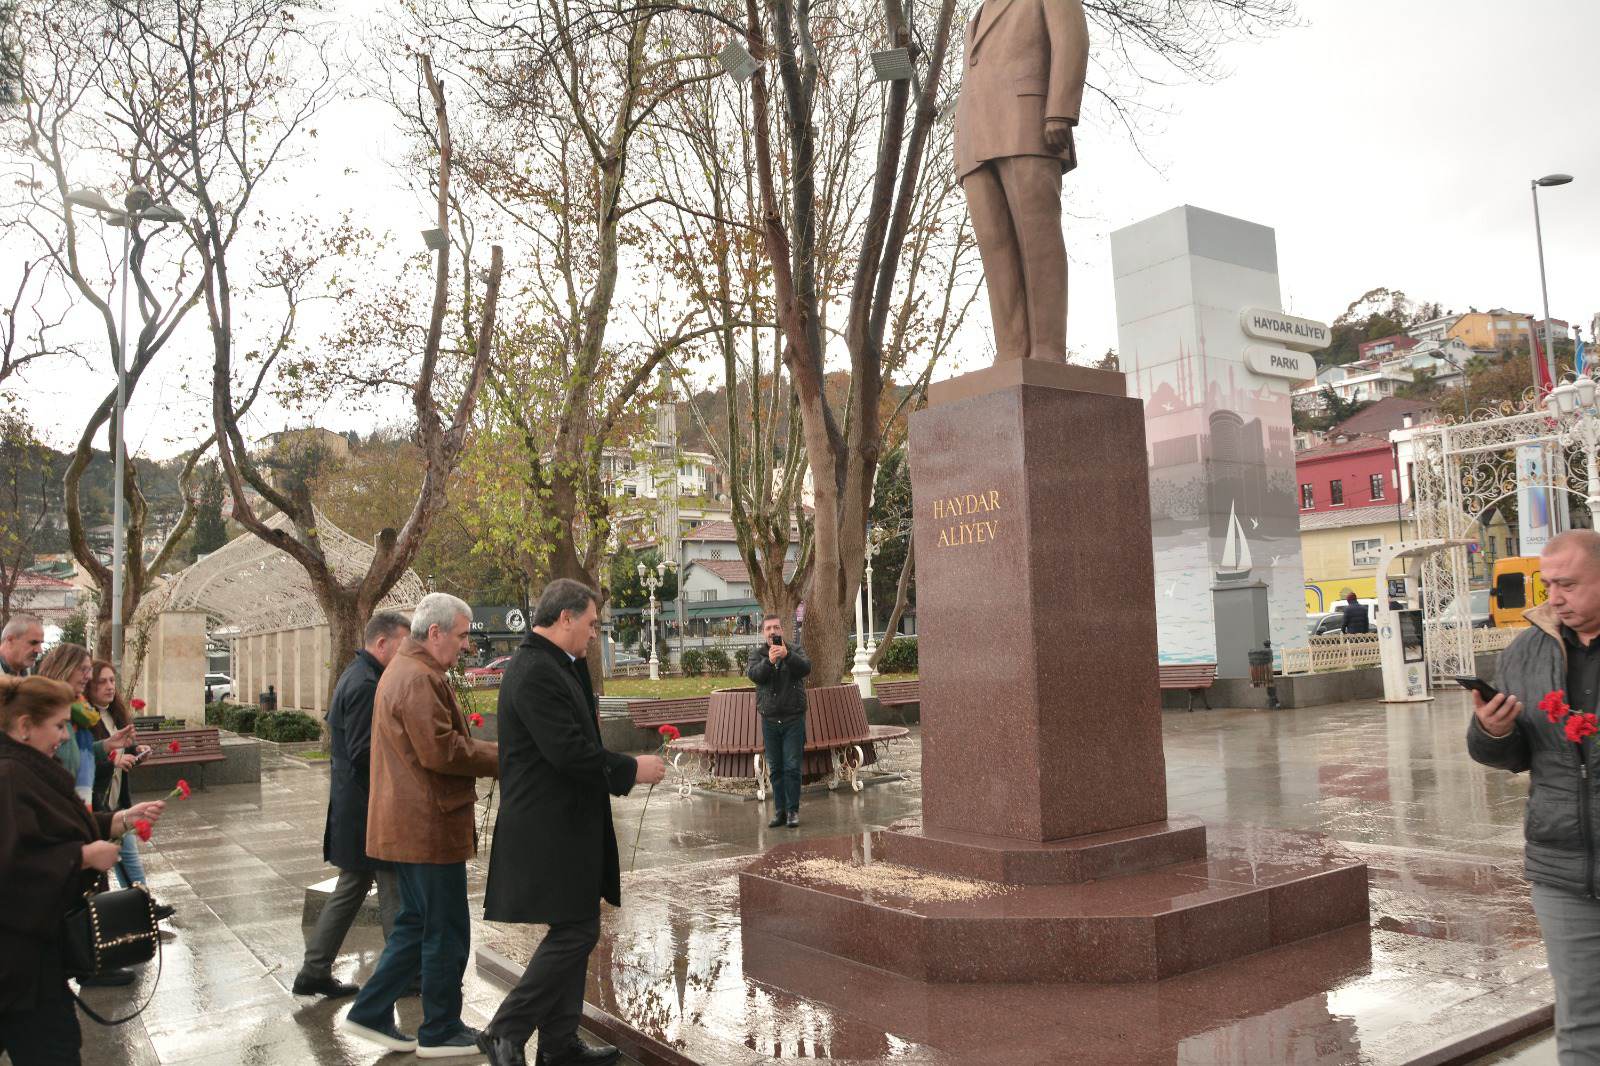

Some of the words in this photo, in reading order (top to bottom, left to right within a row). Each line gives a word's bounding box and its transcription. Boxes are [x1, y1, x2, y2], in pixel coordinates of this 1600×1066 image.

[1254, 316, 1293, 334] HAYDAR
[1295, 323, 1326, 340] ALİYEV
[1270, 355, 1299, 371] PARKI
[933, 490, 1001, 519] HAYDAR
[937, 520, 998, 548] ALİYEV
